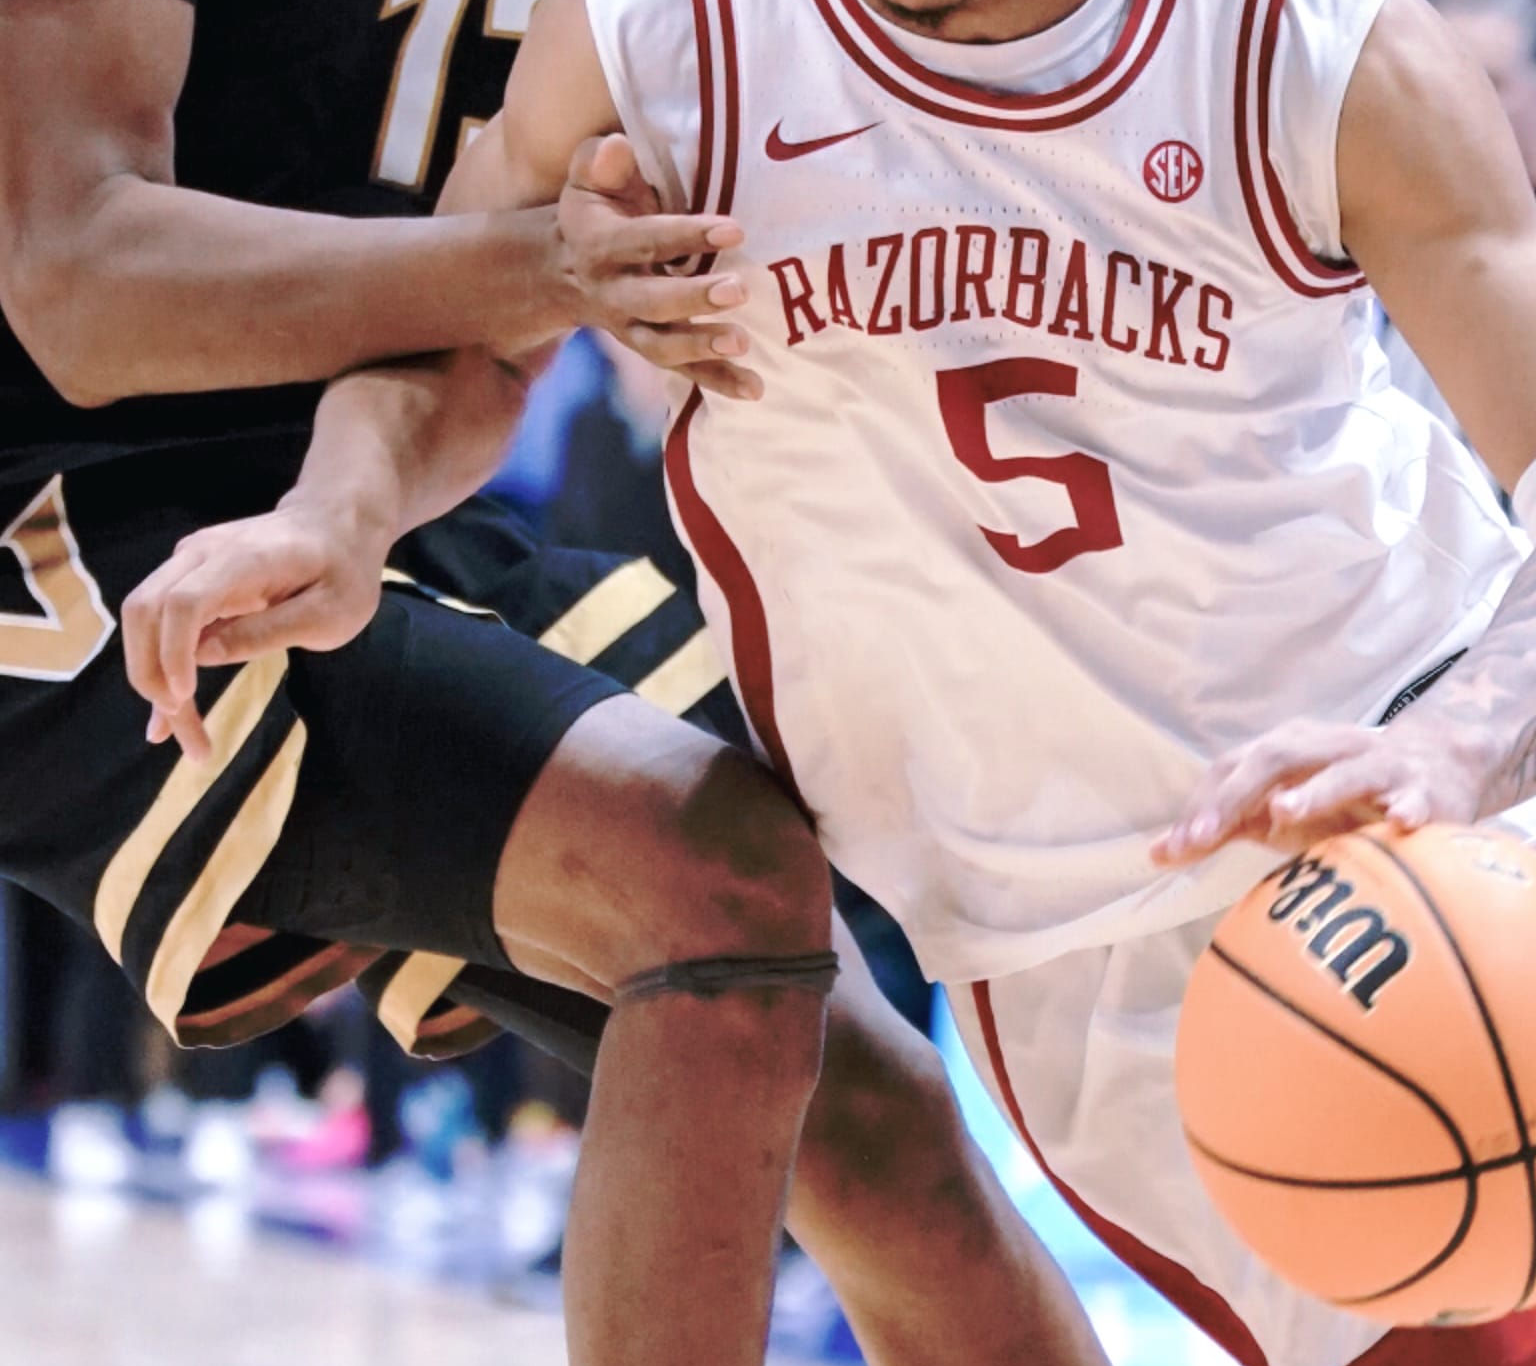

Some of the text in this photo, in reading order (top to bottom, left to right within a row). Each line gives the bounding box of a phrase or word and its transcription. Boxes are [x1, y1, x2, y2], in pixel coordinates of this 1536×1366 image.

[1149, 145, 1199, 198] SEC
[768, 224, 1233, 372] RAZORBACKS
[936, 357, 1124, 574] 5
[1263, 852, 1409, 1010] Wils
